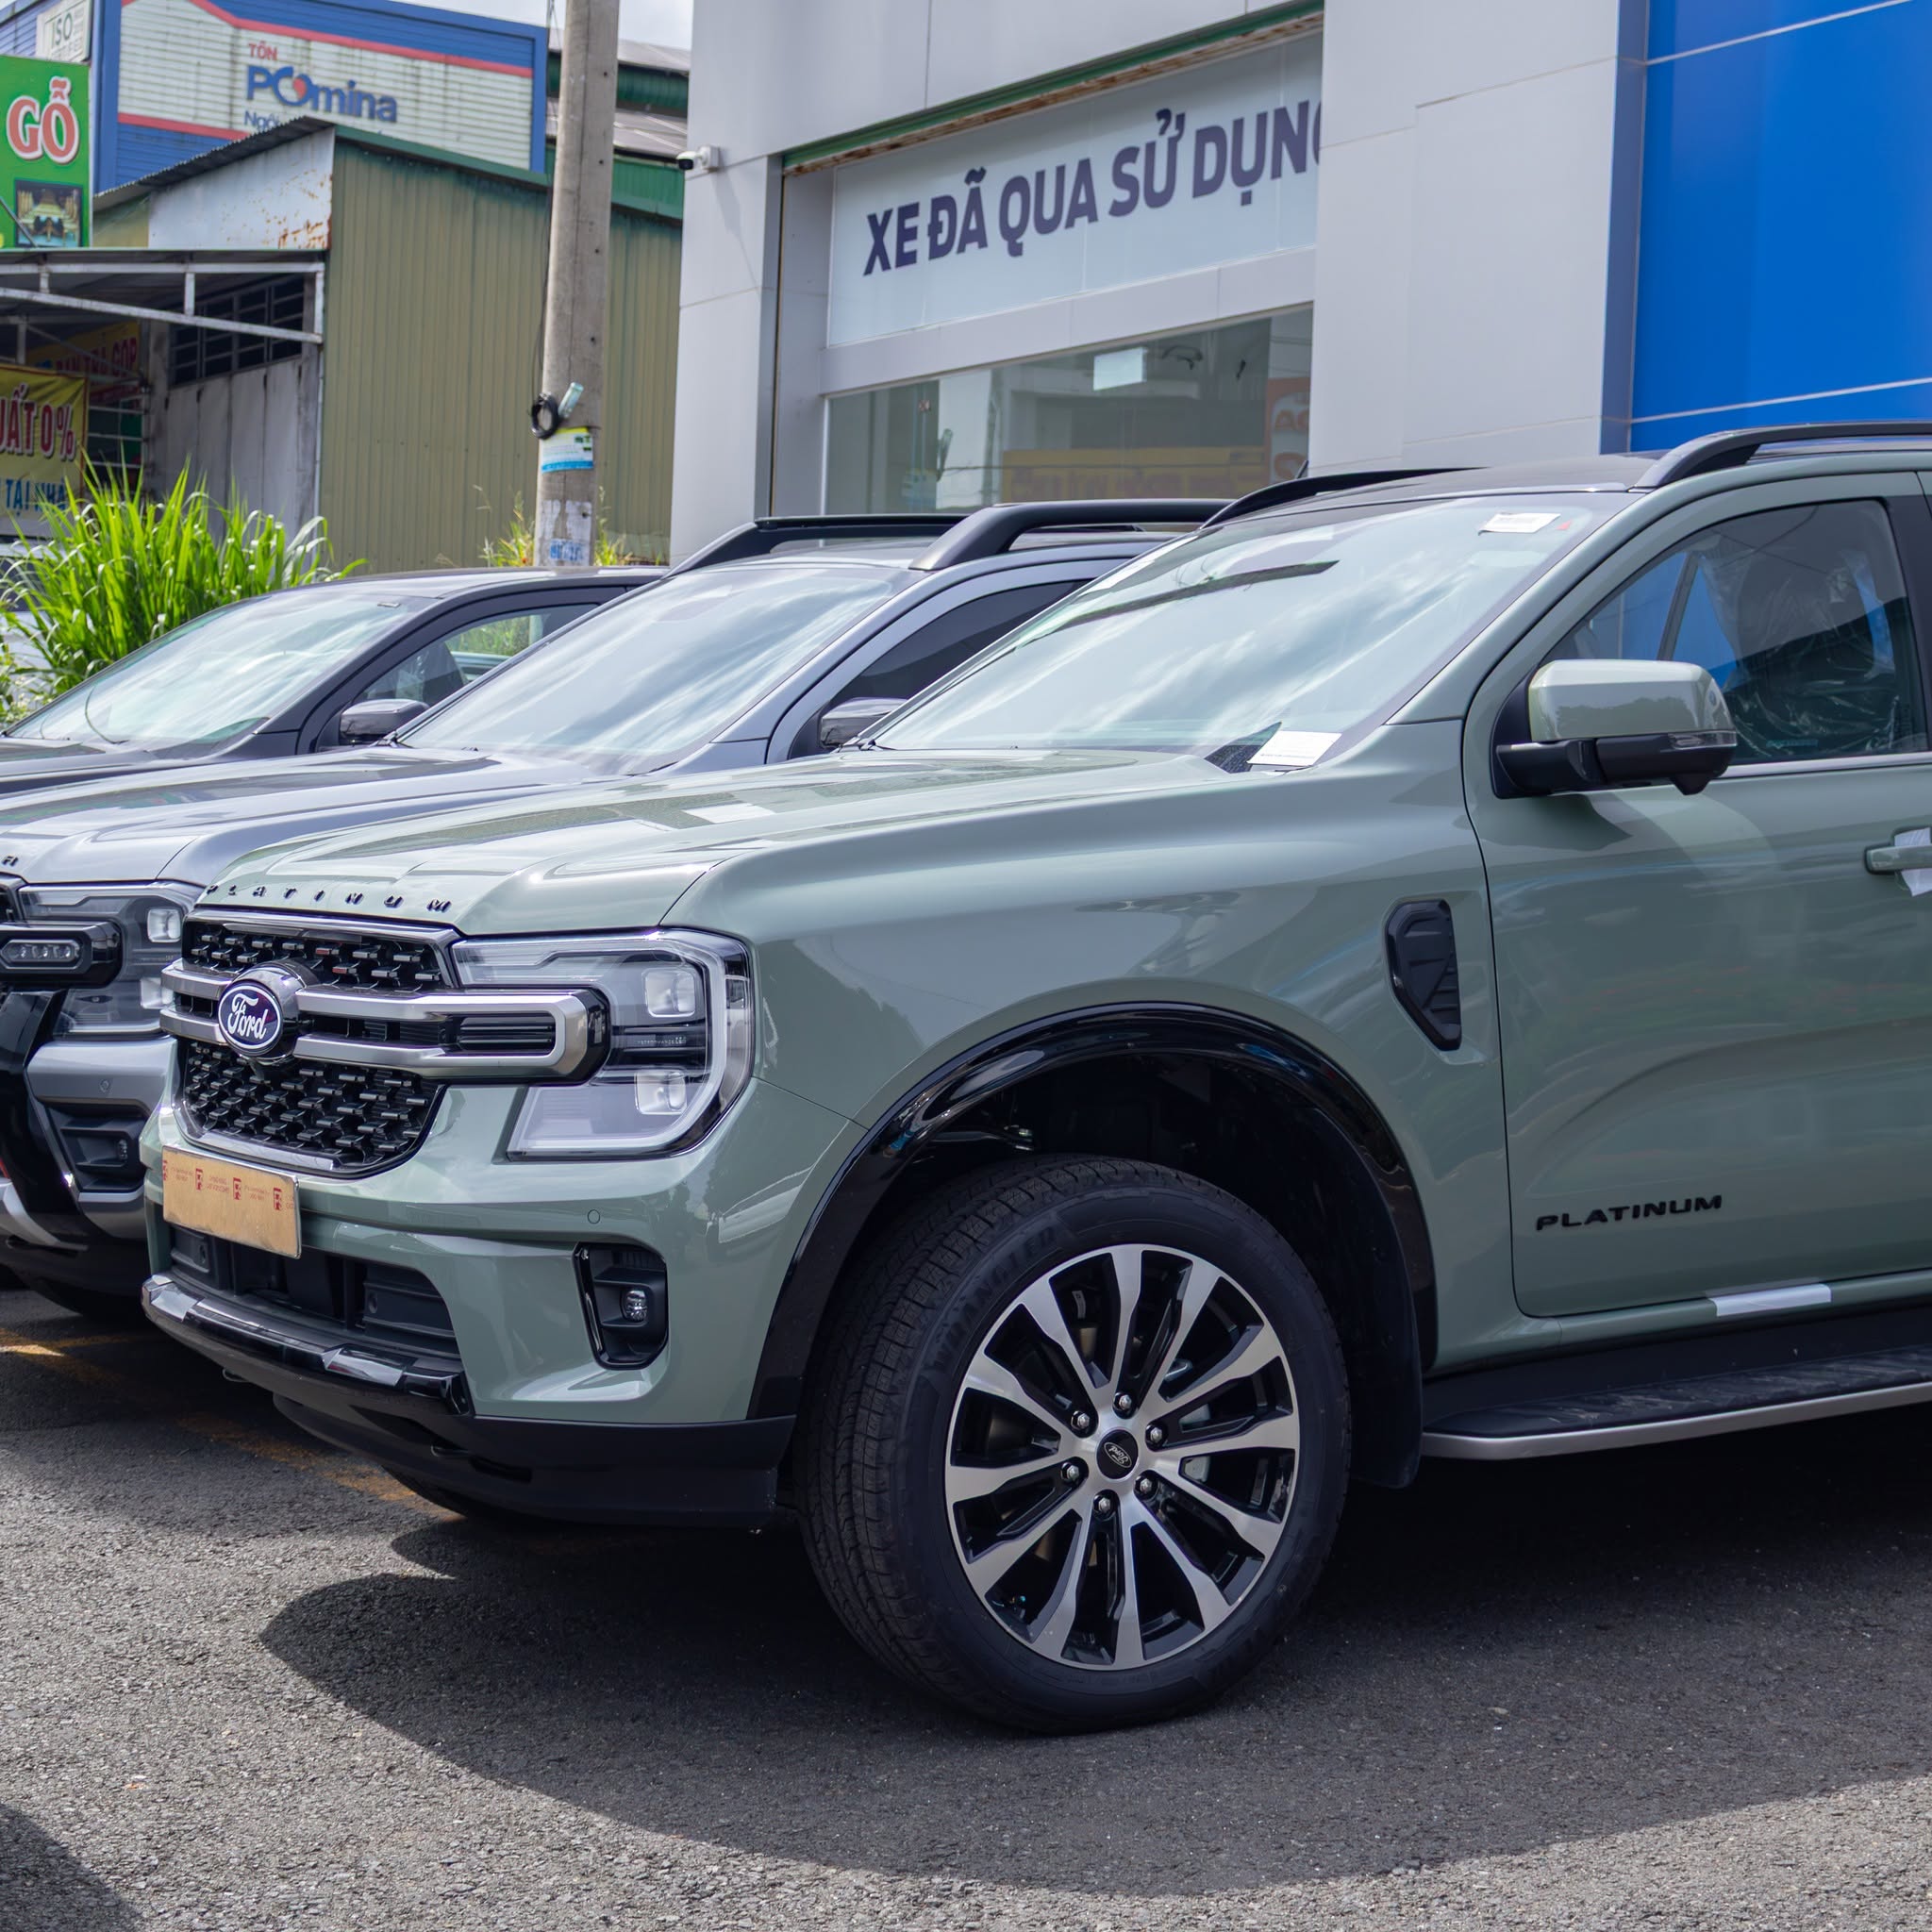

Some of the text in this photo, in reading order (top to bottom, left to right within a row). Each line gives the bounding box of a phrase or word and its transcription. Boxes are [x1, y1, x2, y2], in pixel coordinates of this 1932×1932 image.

[51, 12, 74, 49] ISO
[7, 75, 79, 163] GỖ
[863, 202, 920, 276] XE
[927, 166, 988, 260] ĐÃ
[999, 158, 1098, 258] QUA
[1108, 108, 1186, 218] SỬ
[41, 402, 75, 460] 0%
[6, 478, 30, 516] TẠI
[206, 884, 452, 913] PLATINUM
[227, 992, 269, 1040] Ford
[1536, 1194, 1723, 1231] PLATINUM
[1108, 1444, 1129, 1465] Ford
